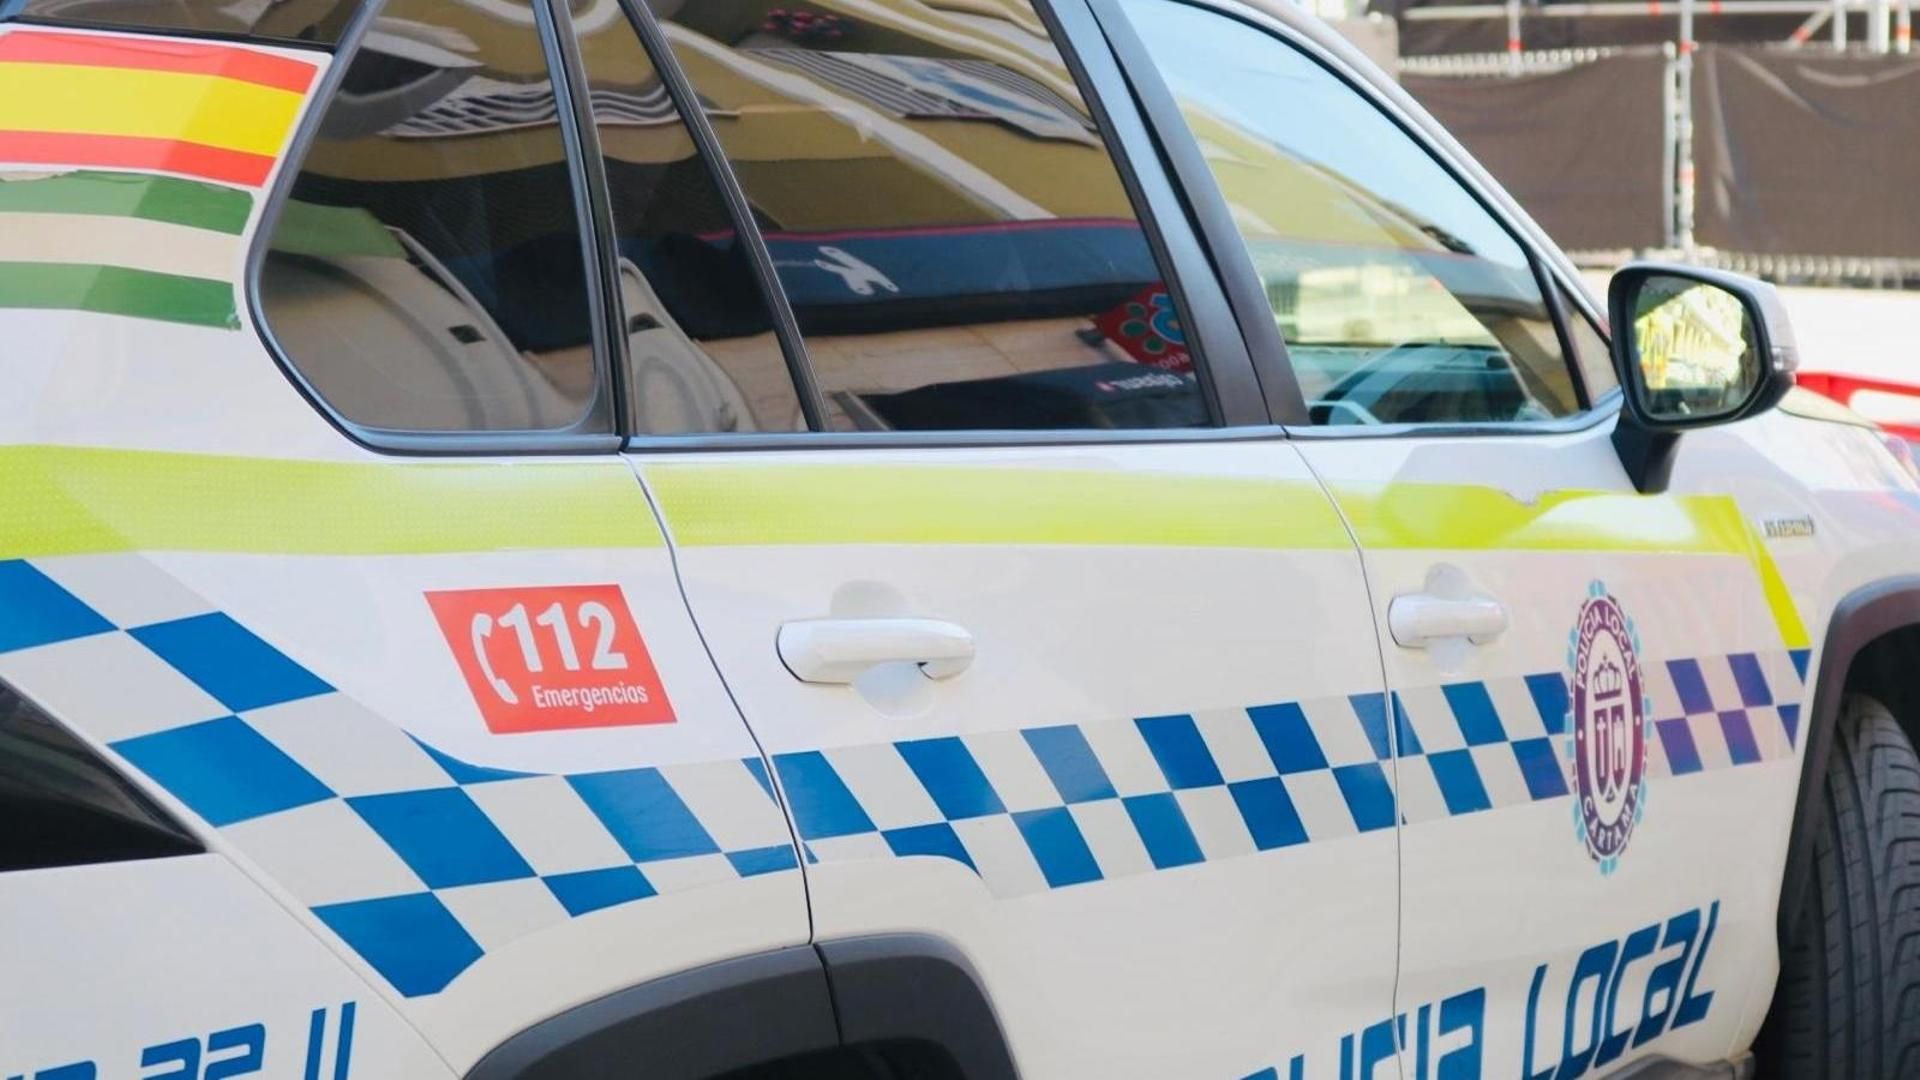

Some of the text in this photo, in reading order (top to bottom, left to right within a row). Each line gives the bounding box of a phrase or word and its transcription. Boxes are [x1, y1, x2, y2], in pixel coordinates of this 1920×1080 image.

[498, 601, 629, 672] 112
[1604, 605, 1637, 681] LOCAL
[531, 682, 649, 712] Emergencias
